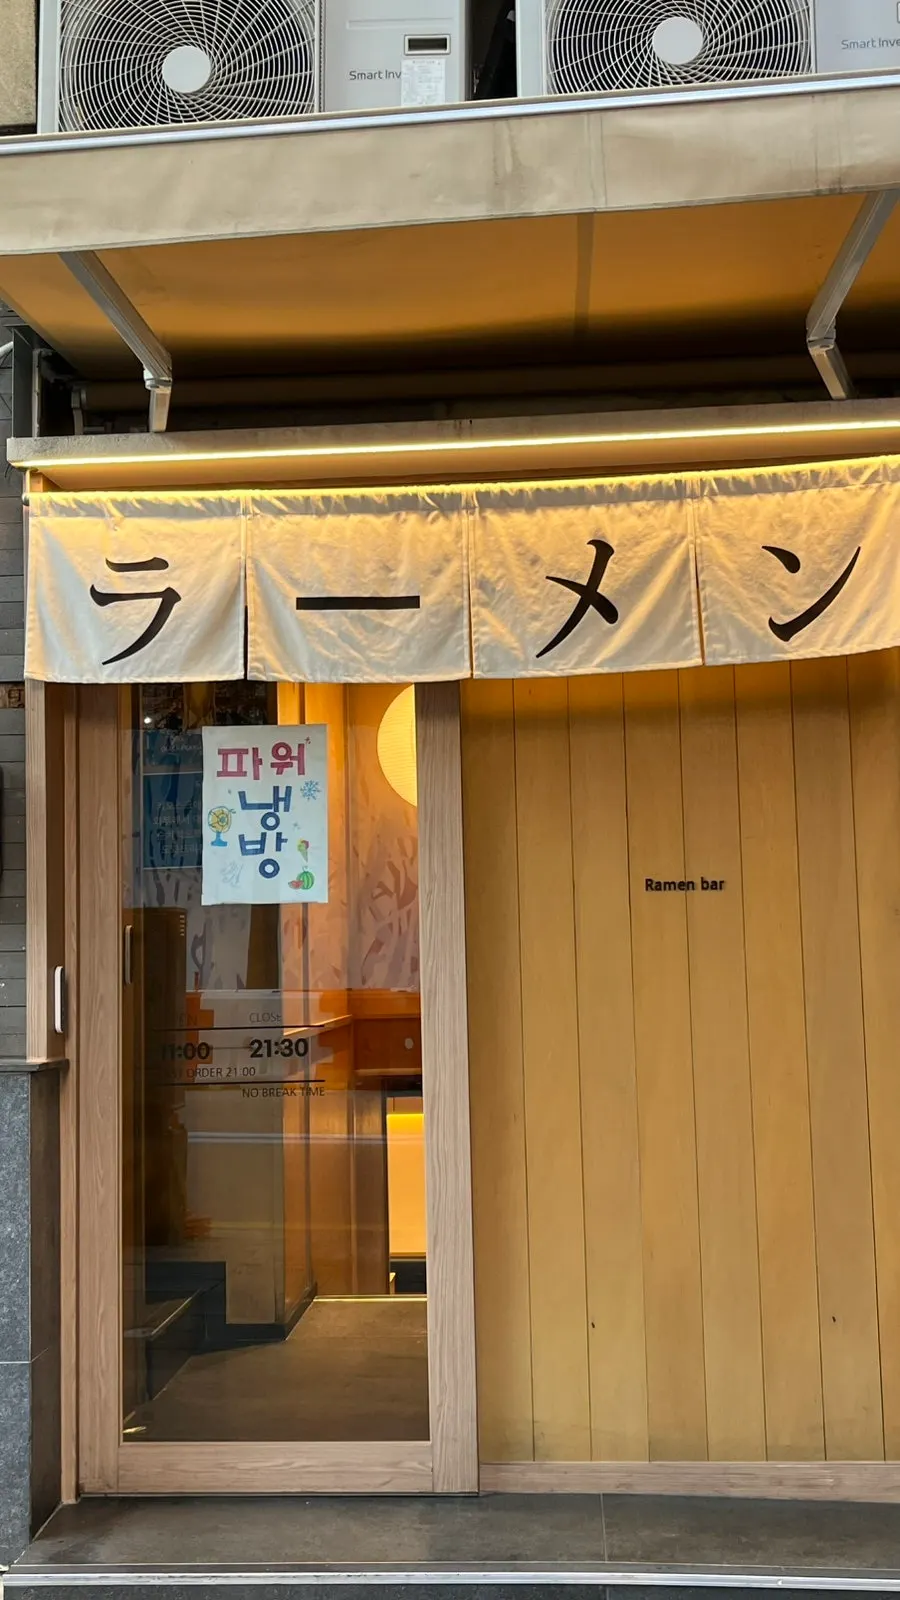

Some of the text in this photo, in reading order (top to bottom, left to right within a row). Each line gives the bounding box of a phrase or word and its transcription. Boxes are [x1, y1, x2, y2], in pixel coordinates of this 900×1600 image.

[841, 37, 877, 50] Smart
[348, 68, 384, 81] Smart
[90, 538, 861, 666] ラーメン
[216, 742, 306, 781] 파워
[645, 876, 725, 892] Ramen bar
[249, 1012, 282, 1024] CLOSE
[161, 1038, 309, 1061] 11:00 21:30
[186, 1067, 224, 1079] ORDER
[241, 1086, 325, 1098] NO BREAK TIME
